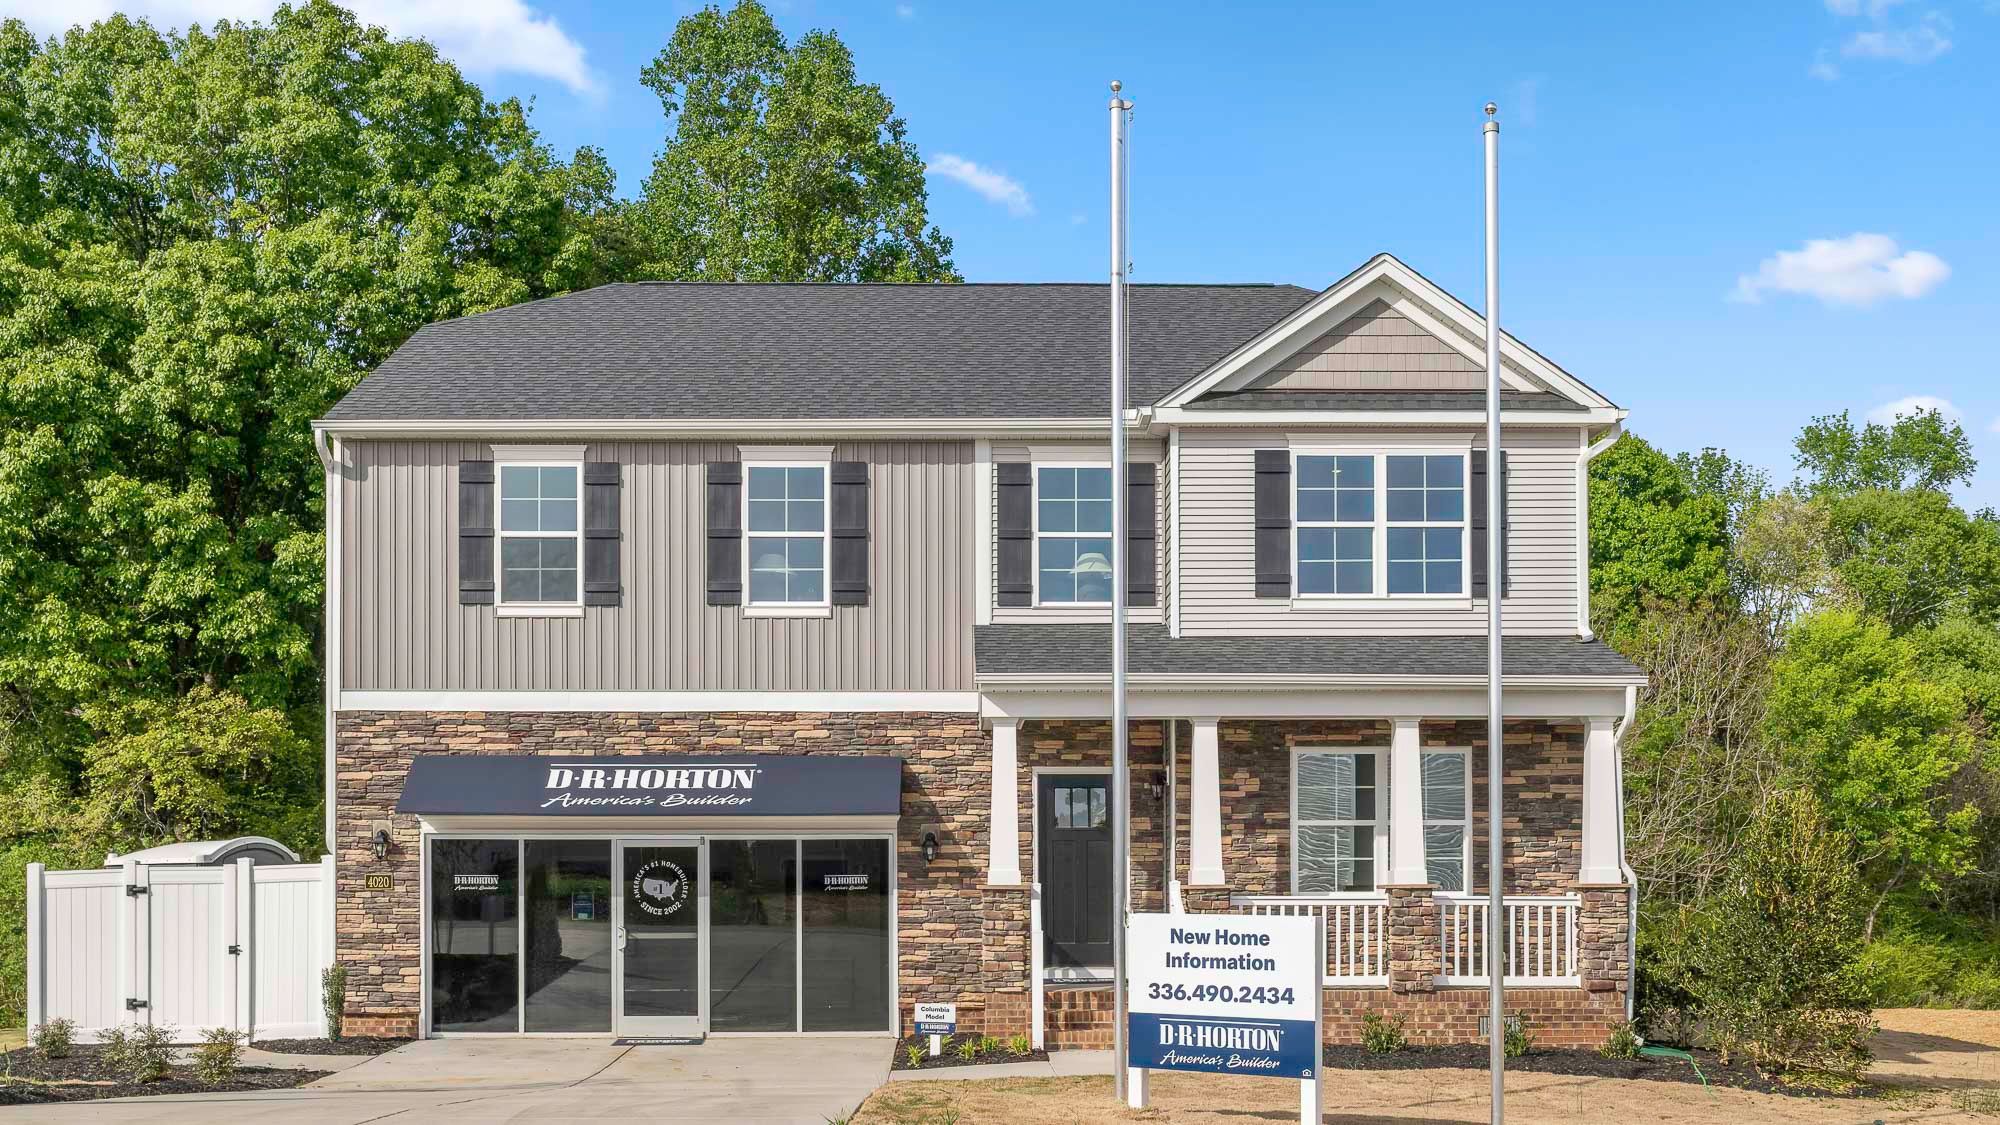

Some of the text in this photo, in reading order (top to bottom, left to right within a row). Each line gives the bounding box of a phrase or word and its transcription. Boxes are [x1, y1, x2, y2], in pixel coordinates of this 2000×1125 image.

[541, 792, 753, 808] America's Builder
[367, 876, 390, 888] 4020
[661, 860, 689, 899] HOMEBUILDER
[640, 901, 682, 915] SINCE 2002
[1170, 928, 1271, 946] New Home
[1165, 952, 1276, 971] Information
[1148, 982, 1295, 1005] 336.490.2434
[1159, 1049, 1281, 1070] America's Builder
